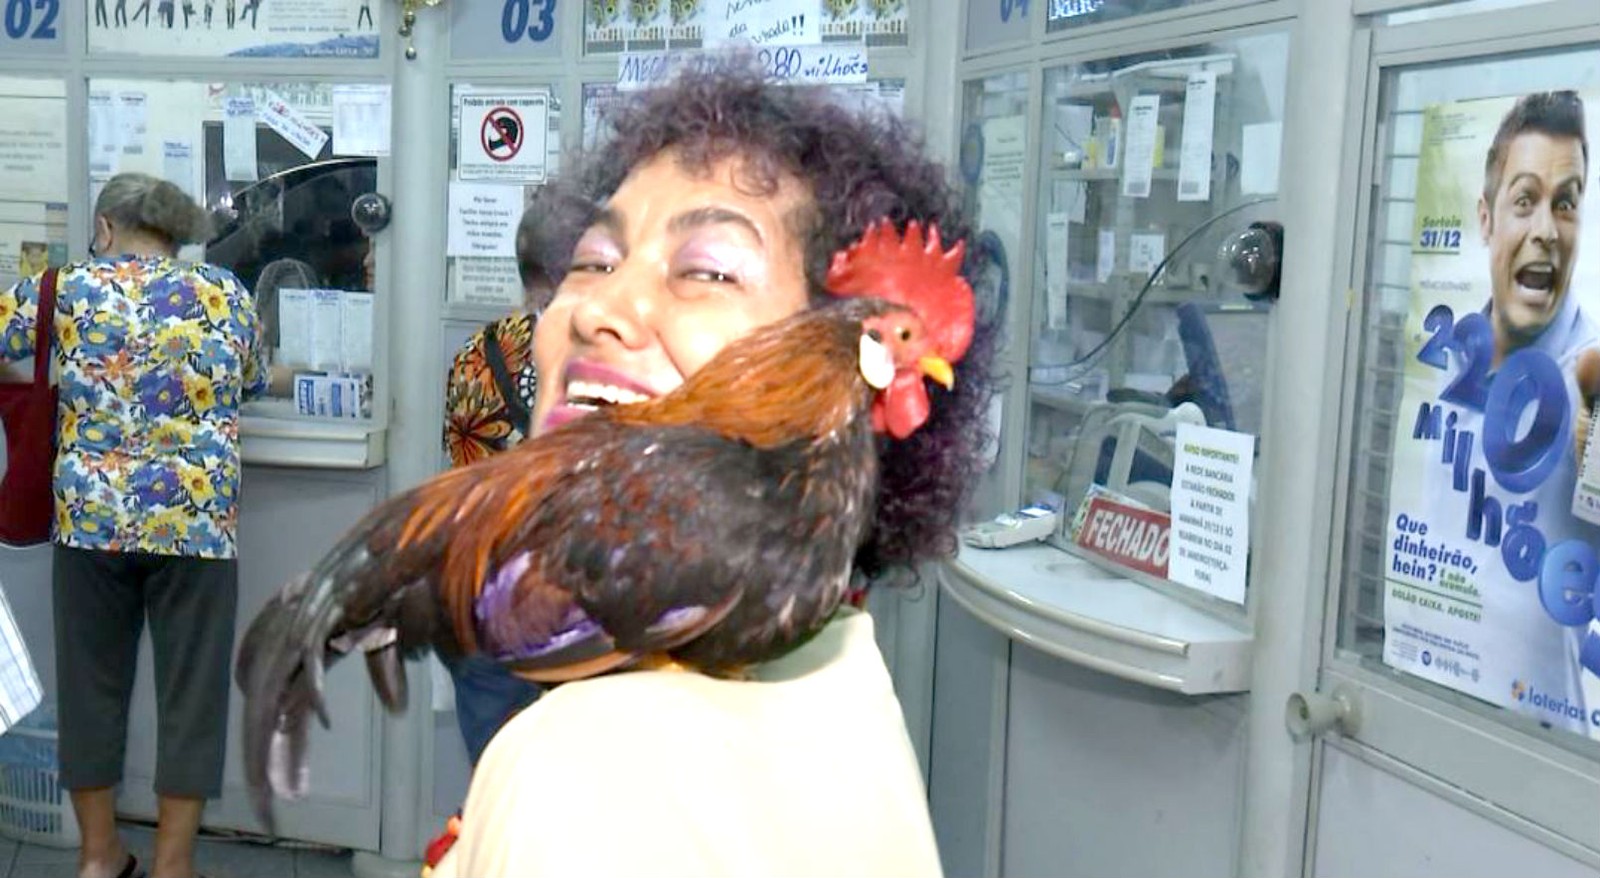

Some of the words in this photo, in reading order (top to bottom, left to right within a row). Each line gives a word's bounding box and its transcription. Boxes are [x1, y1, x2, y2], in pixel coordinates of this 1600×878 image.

[5, 0, 59, 39] 02
[502, 0, 557, 43] 03
[1419, 230, 1462, 249] 31/12
[1085, 509, 1171, 568] FECHADO
[1396, 513, 1428, 535] Que
[1392, 553, 1437, 582] hein?
[1393, 534, 1478, 575] dinheirão,
[1528, 685, 1587, 722] loterias
